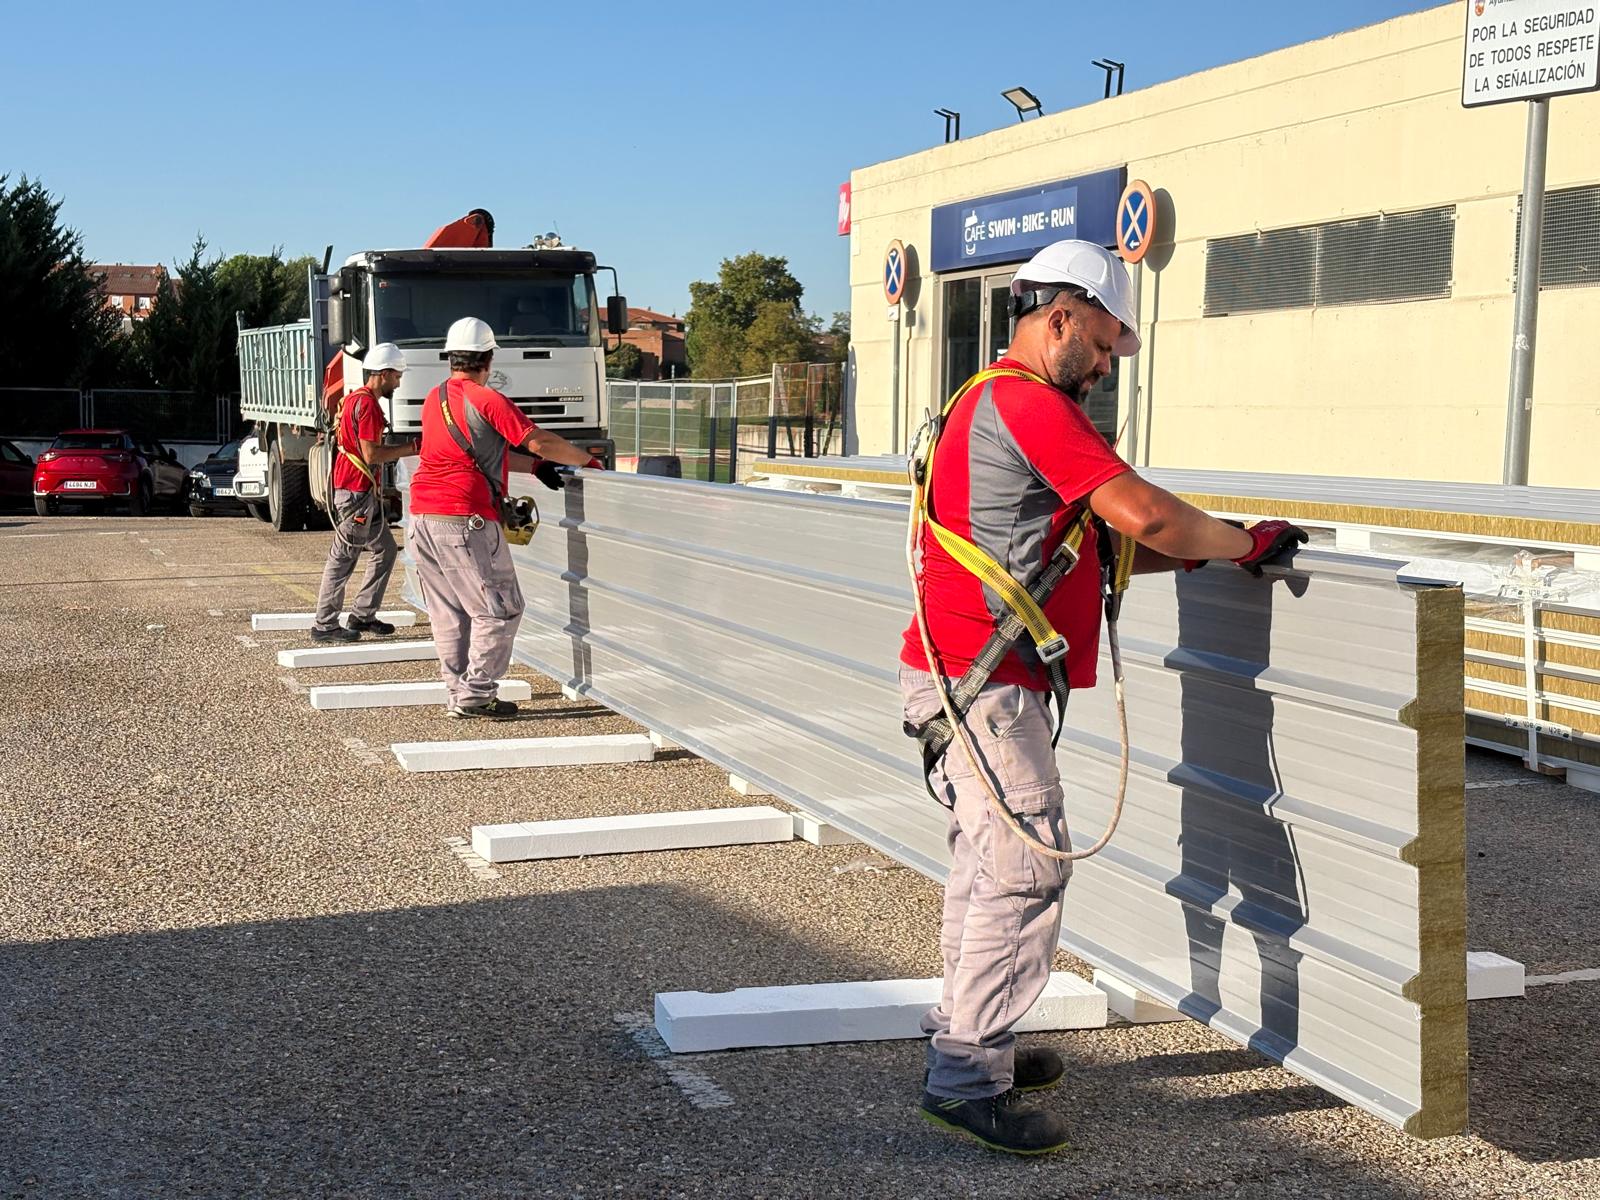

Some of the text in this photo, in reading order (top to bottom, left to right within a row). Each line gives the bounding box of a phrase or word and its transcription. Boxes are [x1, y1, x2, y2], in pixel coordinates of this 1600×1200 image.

[1472, 8, 1594, 42] POR LA SEGURIDAD
[1469, 34, 1594, 68] DE TODOS RESPETE
[1474, 60, 1585, 92] LA SEÑALIZACIÓN
[964, 206, 1074, 242] CAFÉ SWIM BIKE RUN
